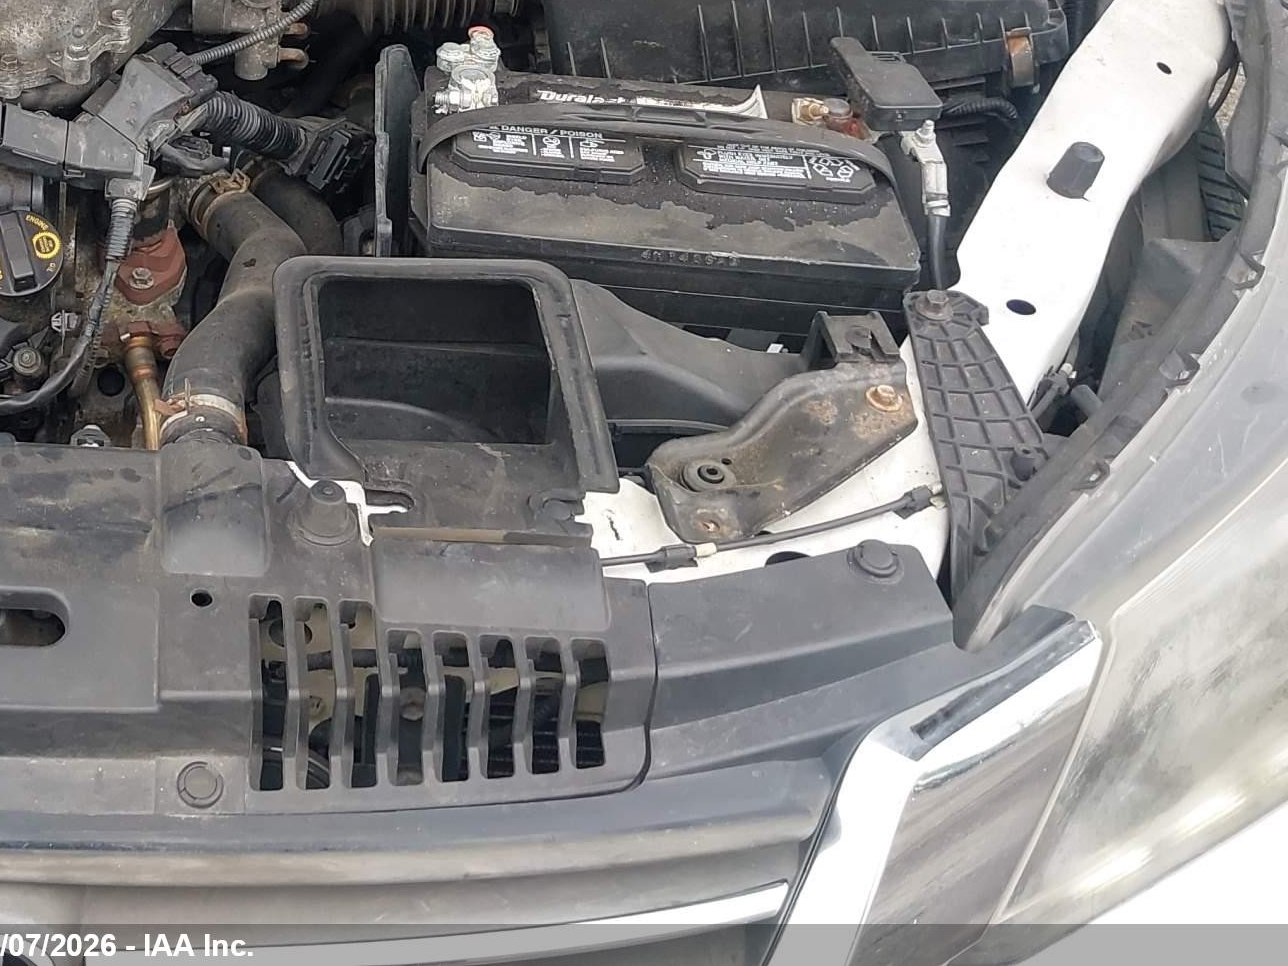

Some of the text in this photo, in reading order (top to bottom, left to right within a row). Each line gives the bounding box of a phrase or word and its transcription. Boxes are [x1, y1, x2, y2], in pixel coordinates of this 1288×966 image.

[501, 125, 548, 135] DANGER
[559, 129, 603, 139] POISON
[25, 214, 49, 231] ENGINE
